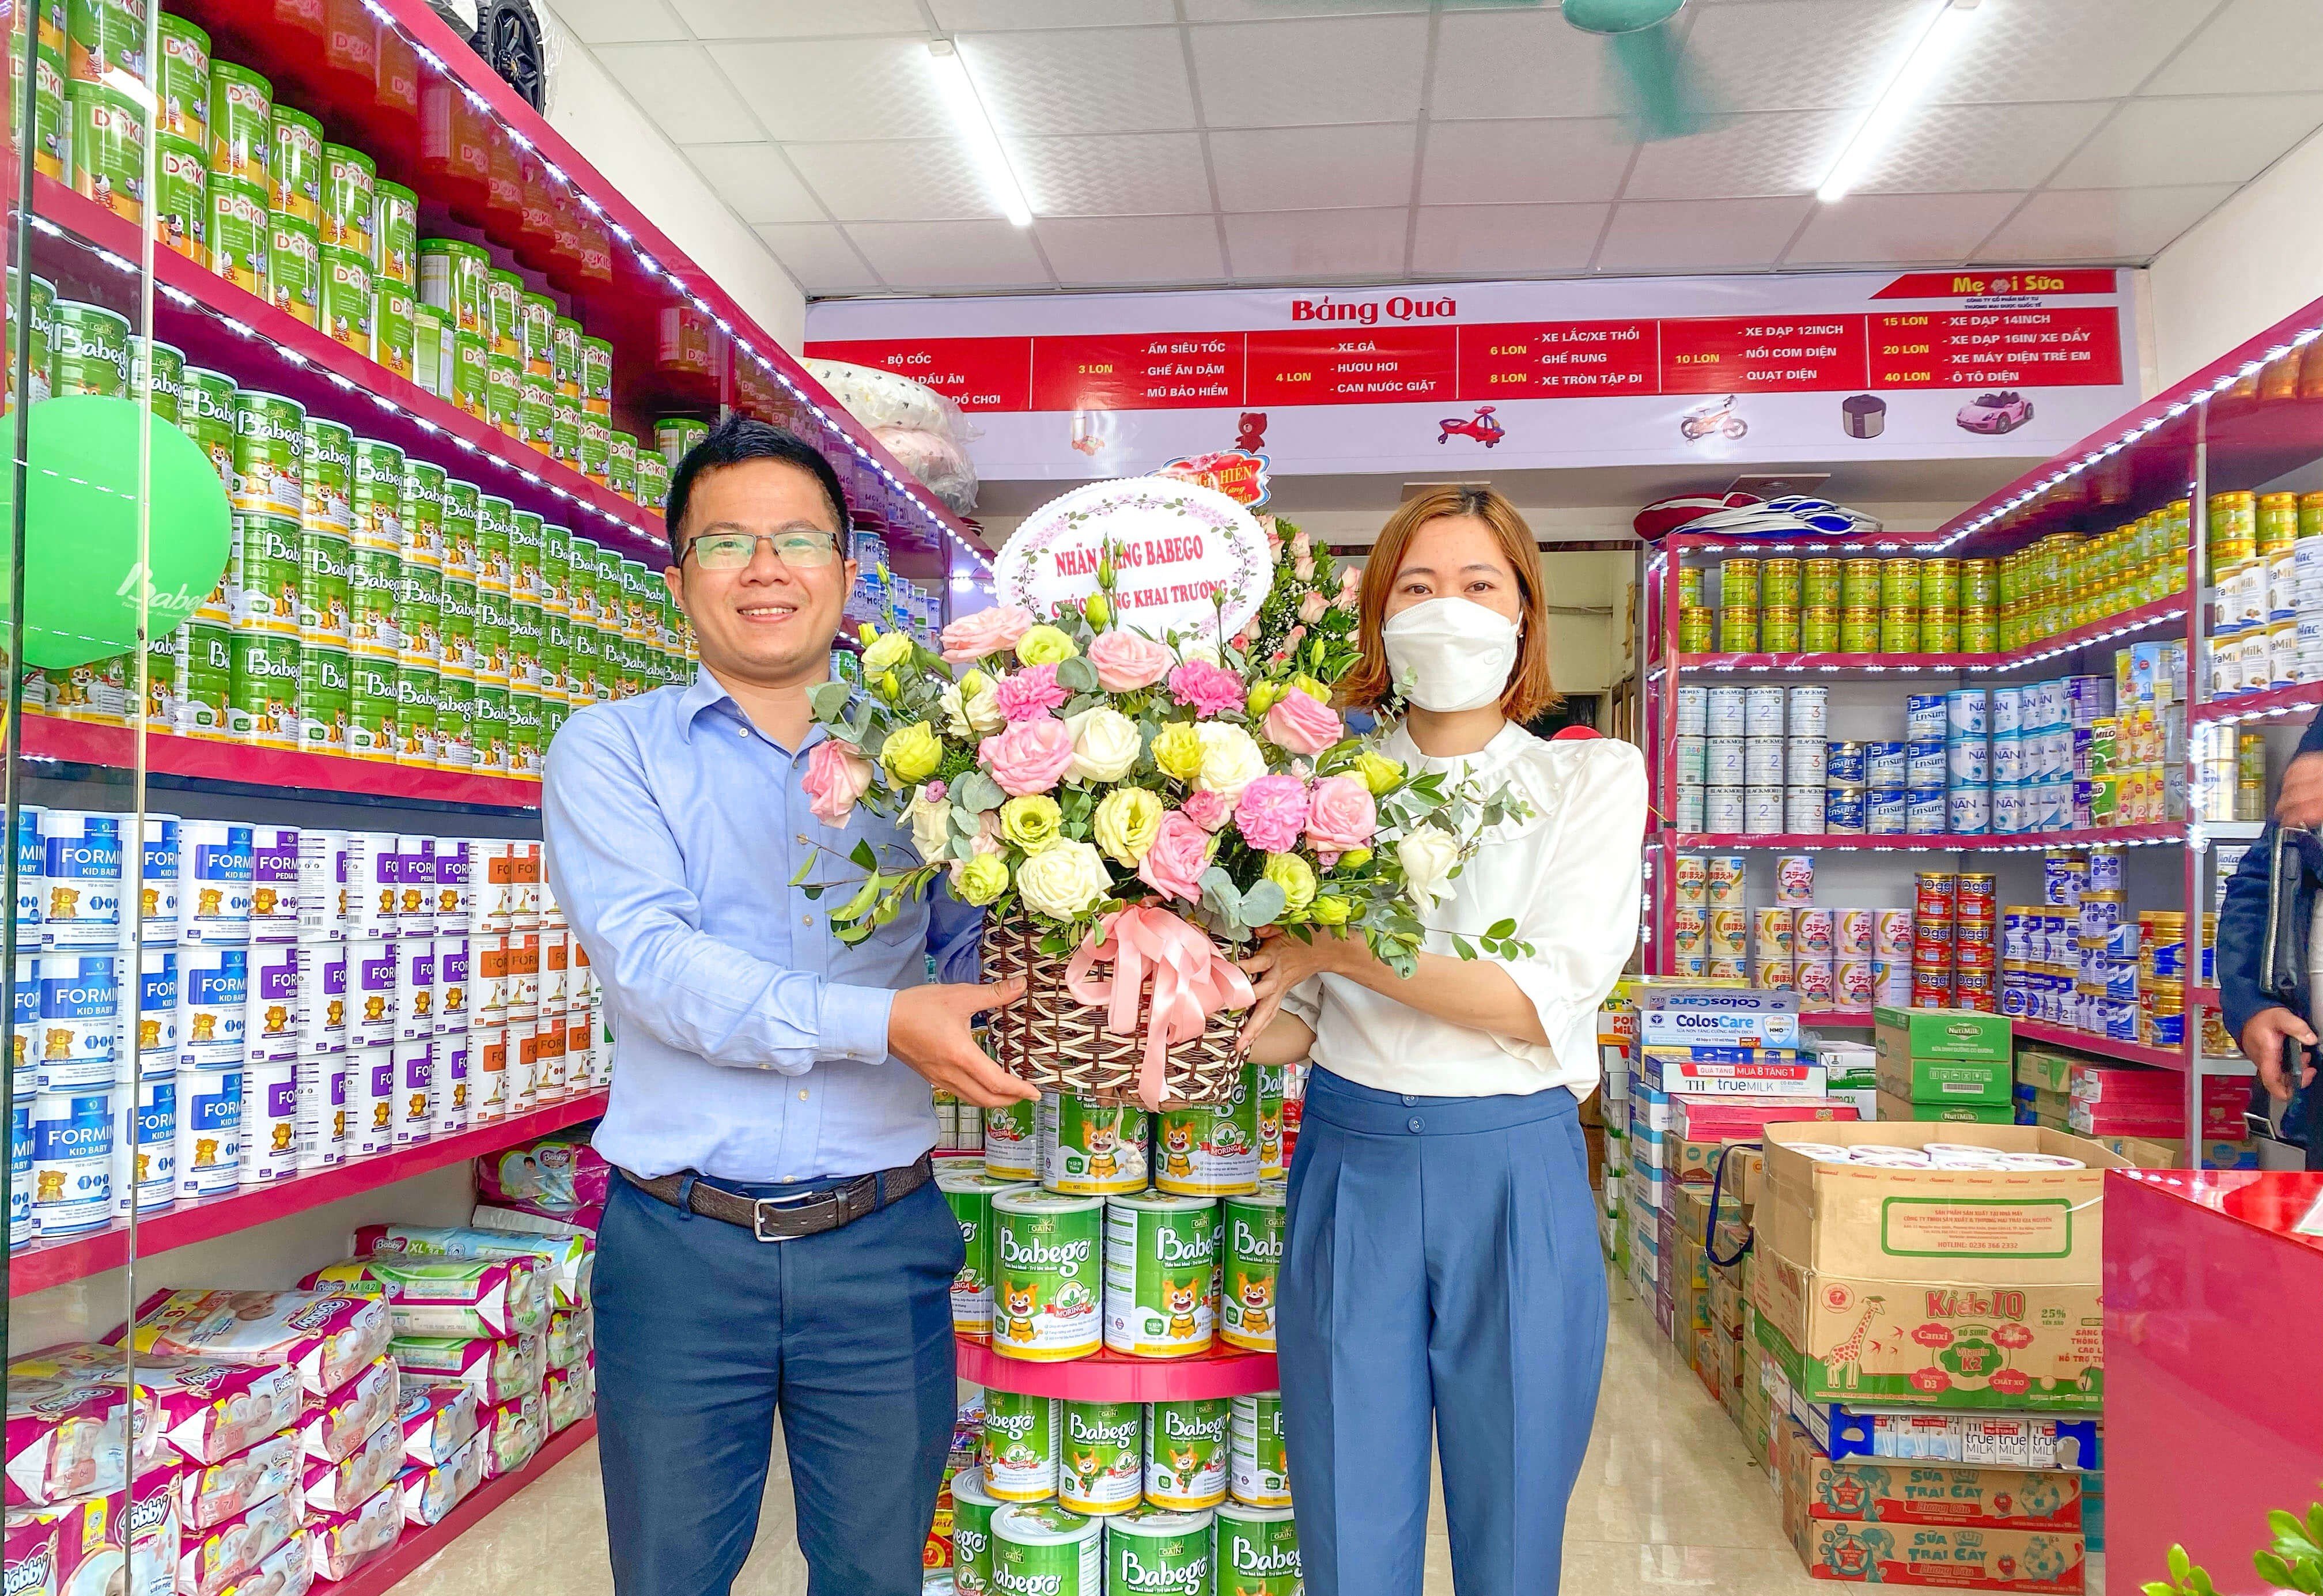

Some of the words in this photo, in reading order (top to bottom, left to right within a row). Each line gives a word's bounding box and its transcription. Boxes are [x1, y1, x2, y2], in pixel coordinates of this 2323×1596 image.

[1953, 277, 1985, 296] Mẹ
[2025, 275, 2064, 290] Sữa
[1292, 296, 1378, 324] Bảng
[1386, 297, 1456, 320] Quà
[1902, 316, 1928, 325] LON
[1950, 317, 1967, 325] XE
[2004, 315, 2050, 324] 14INCH
[1542, 333, 1558, 342] XE
[1562, 328, 1606, 342] LẮC/XE
[1610, 326, 1640, 340] THỔI
[1746, 327, 1762, 336] XE
[1798, 325, 1843, 335] 12INCH
[1951, 335, 1968, 345] XE
[2040, 334, 2058, 343] XE
[54, 324, 126, 379] Babeg
[1148, 342, 1167, 354] ẤM
[1171, 342, 1197, 353] SIÊU
[1201, 340, 1225, 353] TỐC
[1338, 343, 1354, 351] XE
[1358, 341, 1376, 351] GÀ
[1490, 346, 1498, 355] 6
[1502, 346, 1526, 354] LON
[1883, 346, 1899, 354] 20
[1902, 345, 1929, 354] LON
[888, 353, 903, 366] BỘ
[907, 351, 931, 364] CỐC
[1542, 351, 1568, 364] GHẾ
[1571, 354, 1607, 363] RUNG
[1772, 349, 1802, 357] CƠM
[1952, 354, 1969, 363] XE
[1973, 352, 2003, 363] MÁY
[2042, 349, 2067, 361] TRẺ
[2071, 351, 2090, 361] EM
[1676, 355, 1690, 364] 10
[1694, 354, 1719, 363] LON
[1079, 365, 1085, 373] 3
[1089, 364, 1113, 373] LON
[1148, 363, 1173, 376] GHẾ
[1175, 364, 1193, 375] ĂN
[1197, 364, 1224, 377] DẶM
[1338, 362, 1373, 372] HƯƠU
[1377, 362, 1398, 371] HƠI
[948, 373, 964, 384] ĂN
[1276, 373, 1283, 381] 4
[1288, 373, 1311, 381] LON
[1490, 375, 1498, 383] 8
[1502, 373, 1526, 383] LON
[1542, 377, 1558, 385] XE
[1562, 373, 1596, 385] TRÒN
[1601, 373, 1625, 386] TẬP
[1747, 370, 1783, 383] QUẠT
[1885, 373, 1900, 381] 40
[1904, 372, 1930, 381] LON
[1954, 371, 1962, 381] Ô
[1966, 370, 1984, 381] TÔ
[1148, 386, 1166, 397] MŨ
[1170, 385, 1195, 396] BẢO
[1199, 383, 1228, 396] HIỂM
[1338, 383, 1364, 393] CAN
[1368, 380, 1403, 392] NƯỚC
[1407, 380, 1436, 393] GIẶT
[972, 395, 1000, 404] CHƠI
[237, 411, 303, 456] Babeg
[1055, 542, 1097, 577] NHÃN
[1145, 535, 1203, 565] BABEGO
[1134, 587, 1168, 608] KHAI
[248, 649, 301, 690] Babeg
[1727, 706, 1736, 717] 2
[1812, 706, 1821, 717] 3
[2095, 729, 2116, 739] MILO
[1828, 758, 1856, 770] Ensure
[1951, 799, 1977, 808] NAN
[82, 868, 99, 876] KID
[100, 868, 118, 876] BABY
[1785, 871, 1811, 880] ステップ
[1962, 879, 1992, 892] Oggi
[1676, 1014, 1754, 1028] ColosCare
[1736, 1067, 1756, 1076] MUA
[1757, 1067, 1763, 1076] 8
[1790, 1067, 1795, 1076] 1
[1686, 1079, 1705, 1091] TH
[1211, 1144, 1242, 1156] MORINGA
[409, 1241, 425, 1254] XL
[1000, 1227, 1091, 1278] Babego
[350, 1282, 358, 1291] M
[365, 1283, 376, 1291] 42
[1055, 1305, 1087, 1318] MORINGA
[2041, 1308, 2066, 1318] 25%
[1918, 1330, 1949, 1341] Canxi
[1956, 1347, 1990, 1357] Vitamin
[1962, 1356, 1982, 1371] K2
[1924, 1379, 1937, 1389] D3
[1070, 1412, 1138, 1449] Babego
[1965, 1432, 1993, 1446] true
[1966, 1445, 1994, 1455] MILK
[1122, 1549, 1208, 1595] Babego
